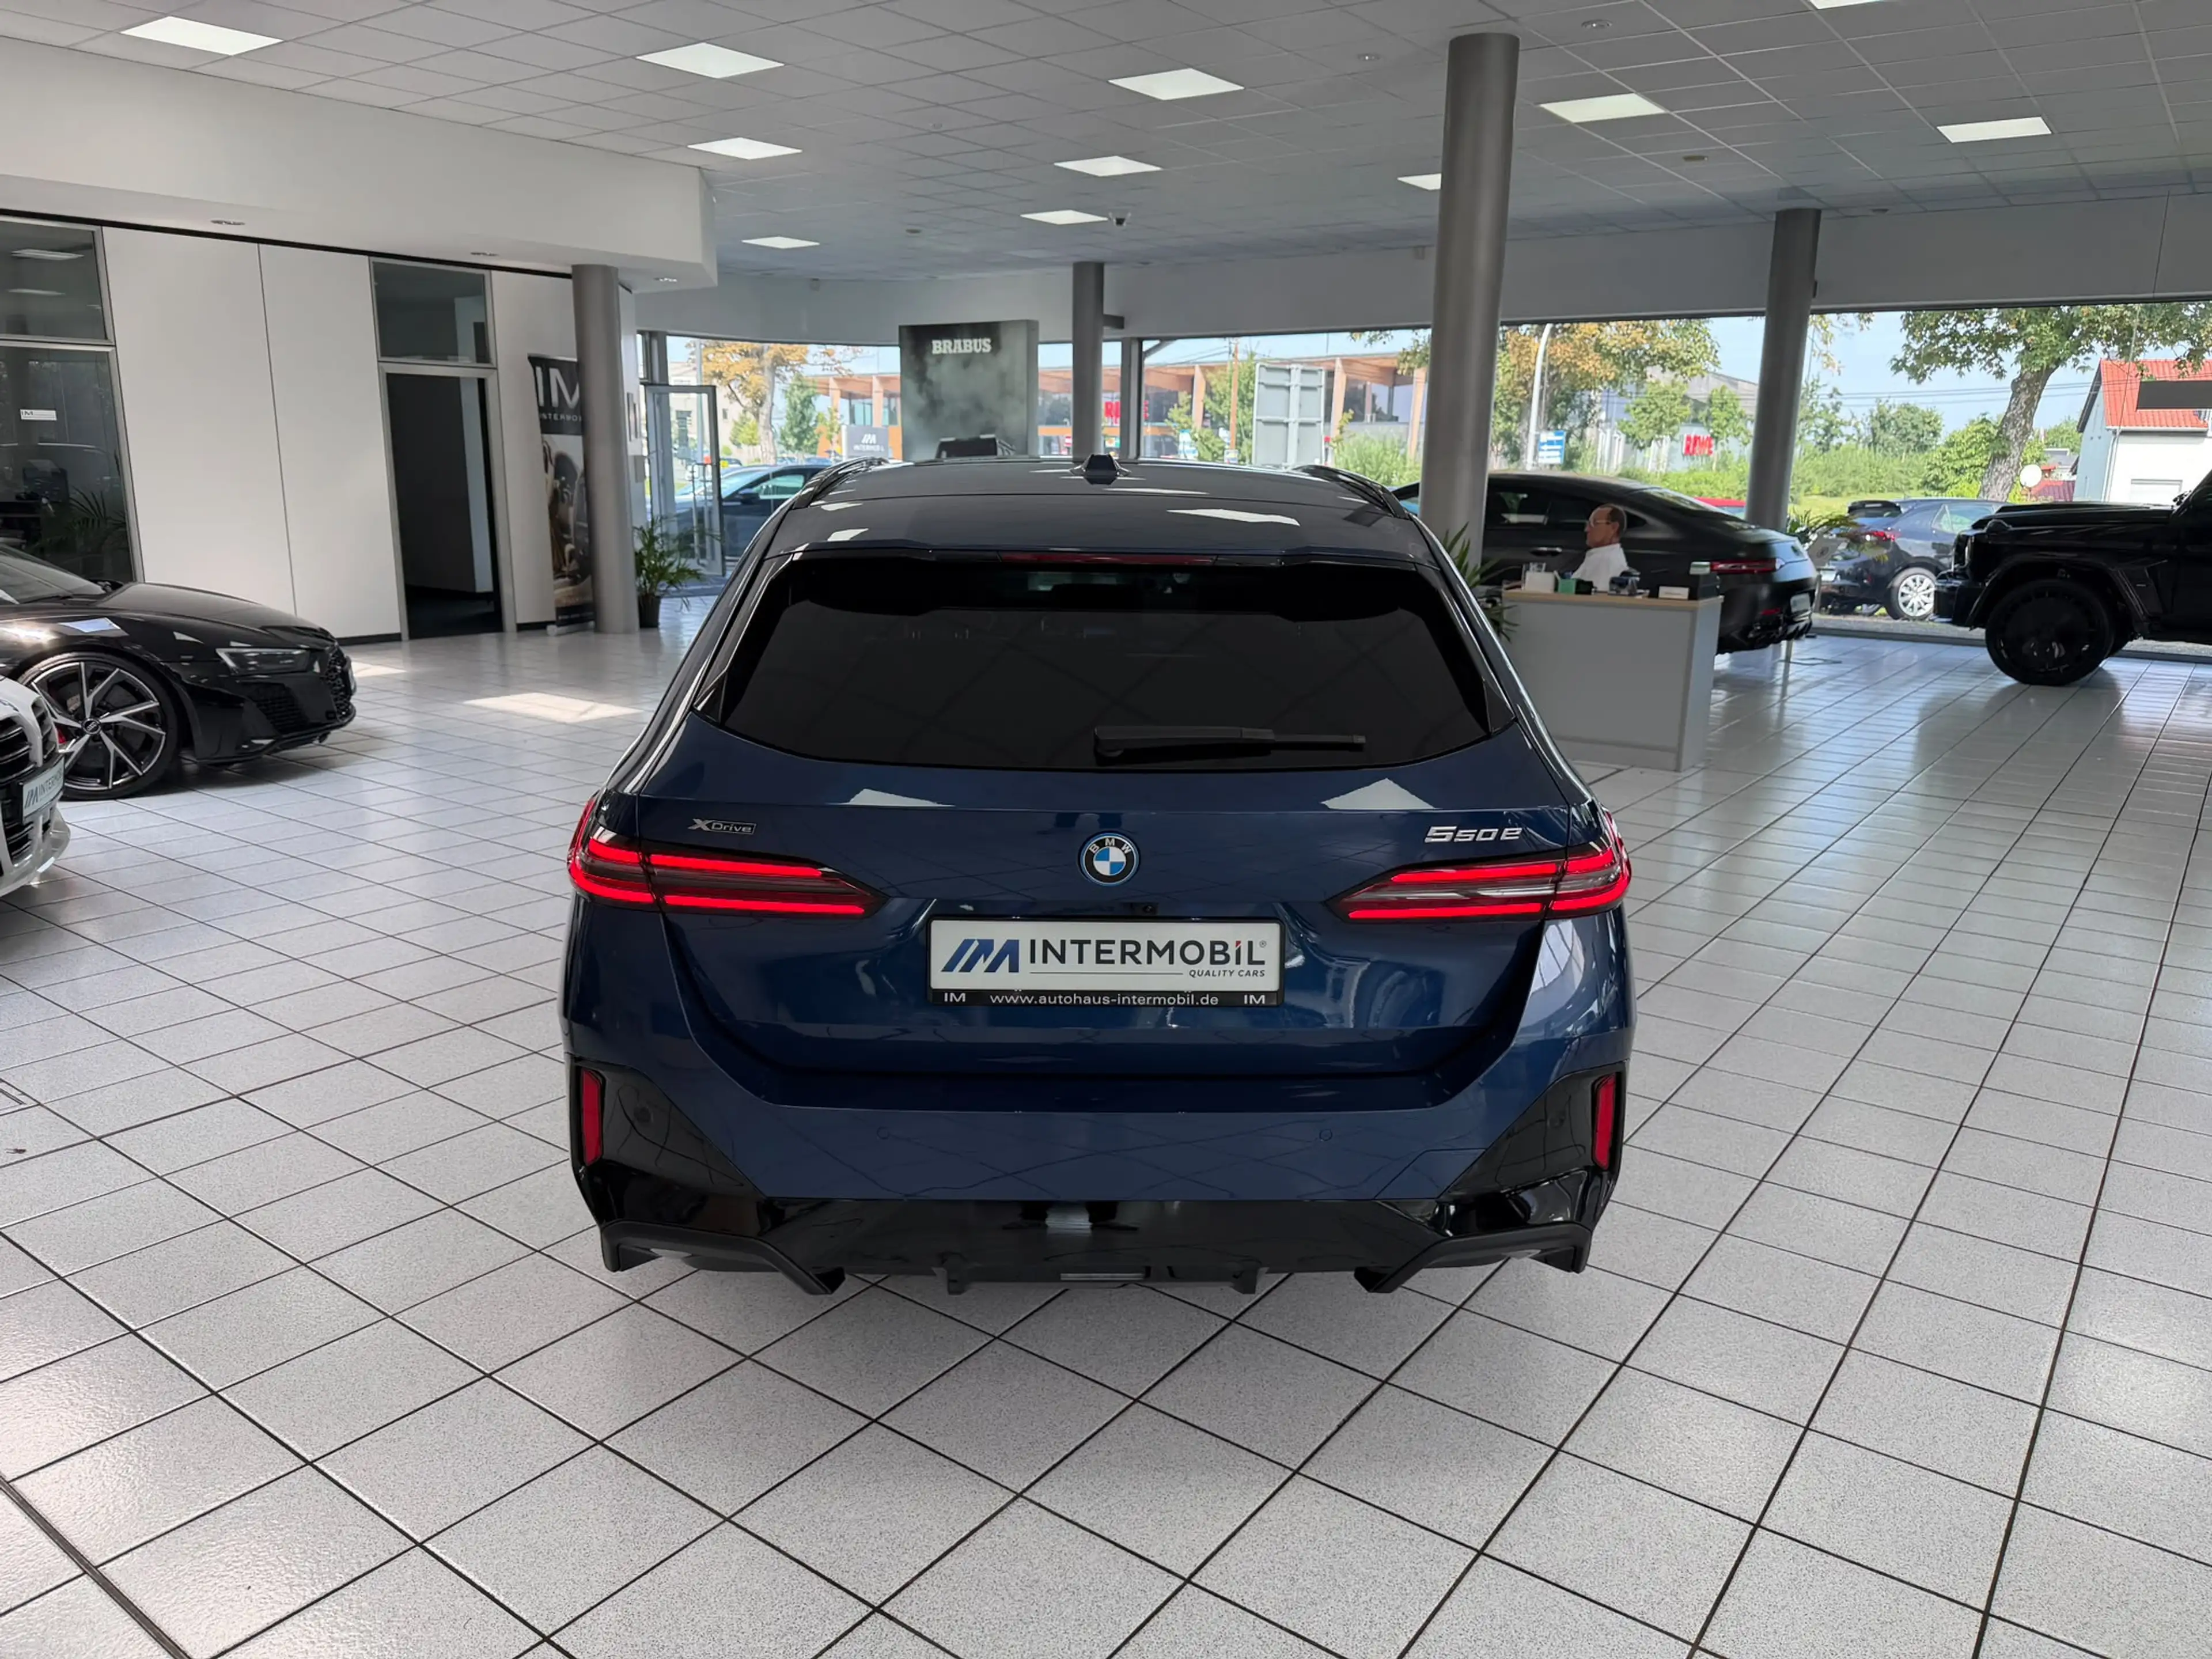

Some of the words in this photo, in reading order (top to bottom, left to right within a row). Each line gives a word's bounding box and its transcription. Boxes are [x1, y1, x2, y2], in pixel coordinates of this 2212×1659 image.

[932, 338, 991, 354] BRABUS
[1089, 838, 1131, 854] BMW
[1189, 969, 1234, 978] QUALITY
[1237, 969, 1266, 978] CARS
[944, 993, 966, 1002] IM
[990, 993, 1219, 1006] www.autohaus-intermobil.de
[1243, 994, 1266, 1005] IM
